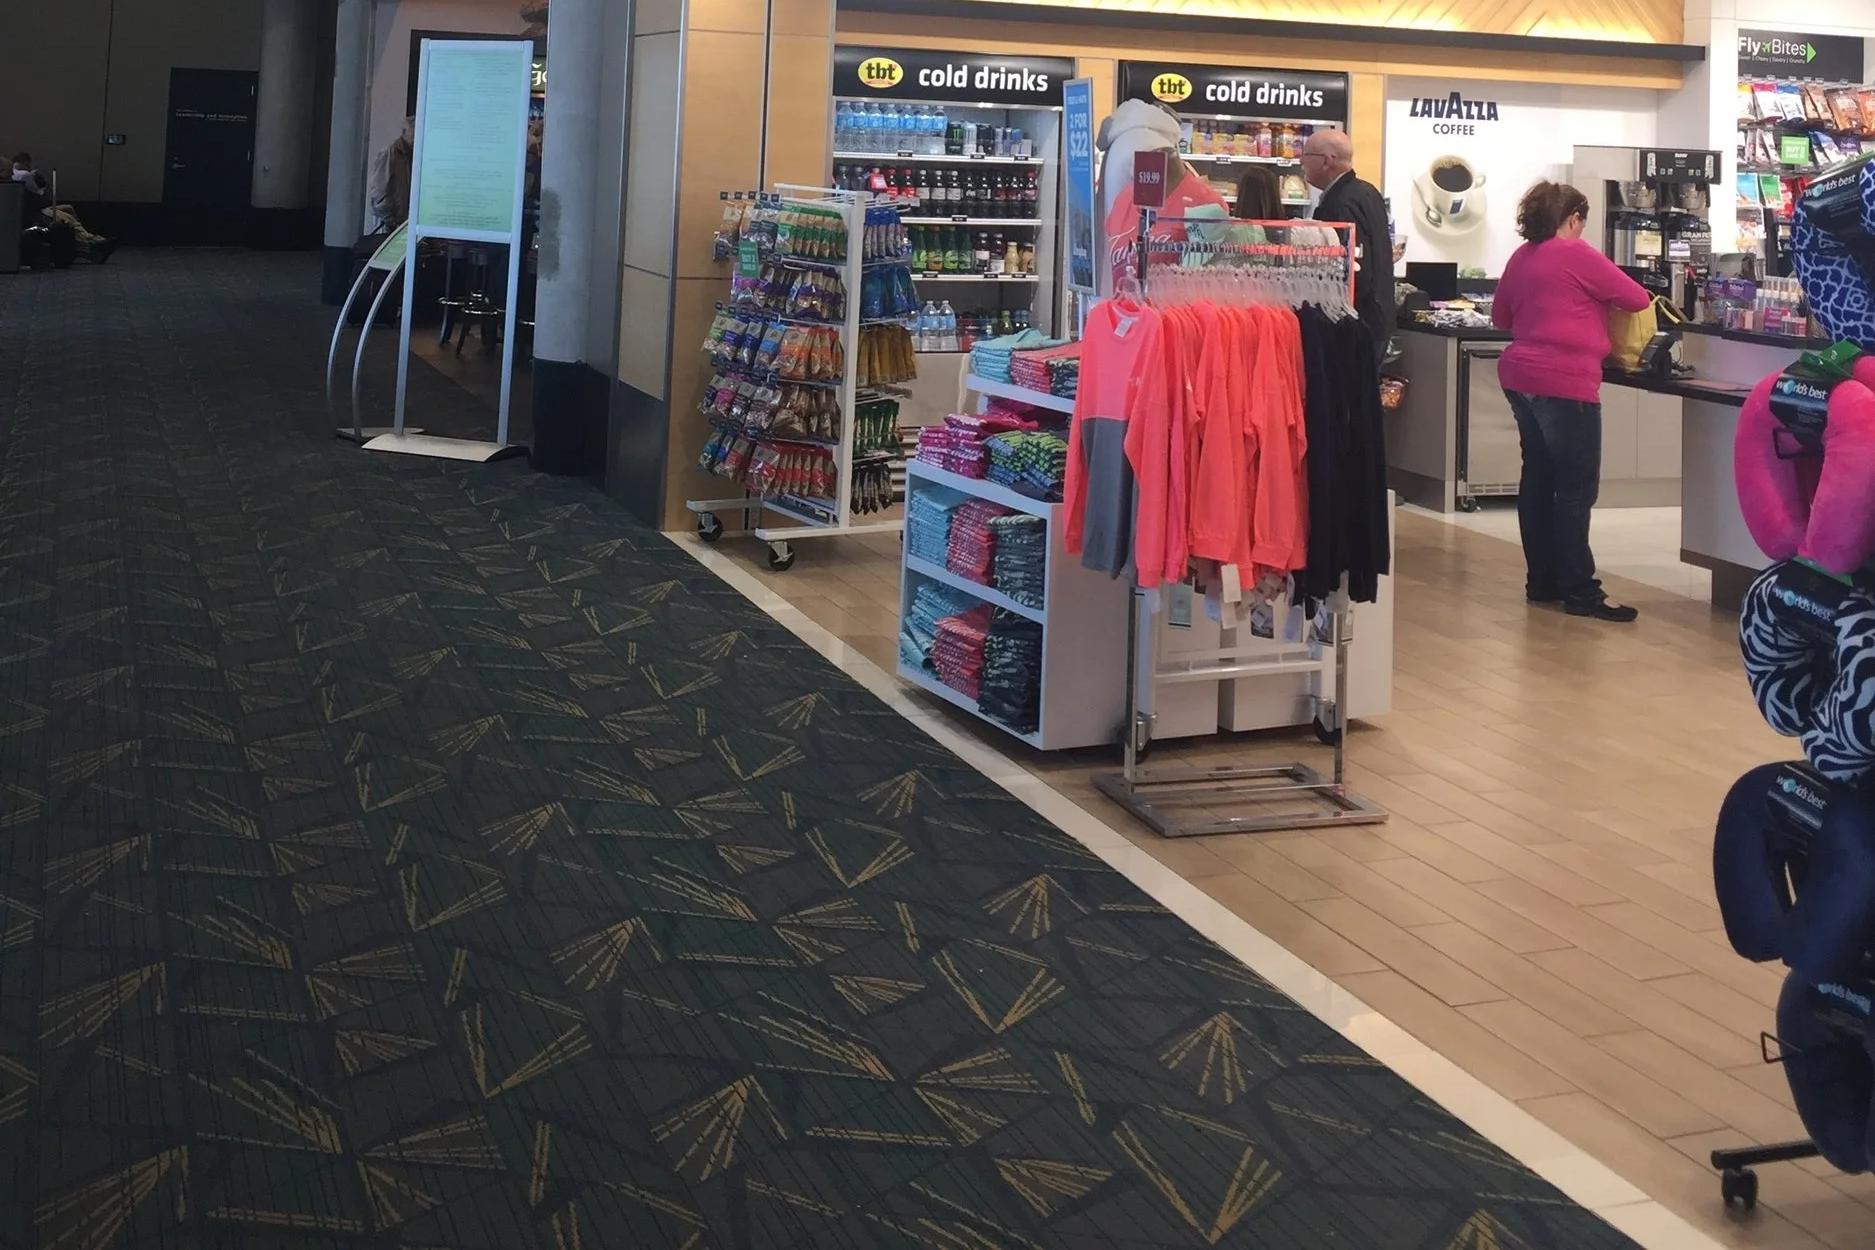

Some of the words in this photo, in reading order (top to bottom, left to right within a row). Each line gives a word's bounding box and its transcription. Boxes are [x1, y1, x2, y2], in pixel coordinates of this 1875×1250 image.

[1739, 36, 1761, 56] Fly
[1772, 38, 1806, 56] Bites
[866, 62, 896, 81] tbt
[919, 63, 968, 88] cold
[974, 65, 1049, 92] drinks
[1158, 78, 1185, 95] tbt
[1206, 80, 1250, 103] cold
[1256, 81, 1324, 107] drinks
[1409, 91, 1499, 121] LAVAZZA
[1433, 123, 1475, 136] COFFEE
[1138, 172, 1160, 184] $19.99
[1838, 173, 1857, 187] best
[1808, 385, 1828, 400] best
[1811, 602, 1832, 621] best
